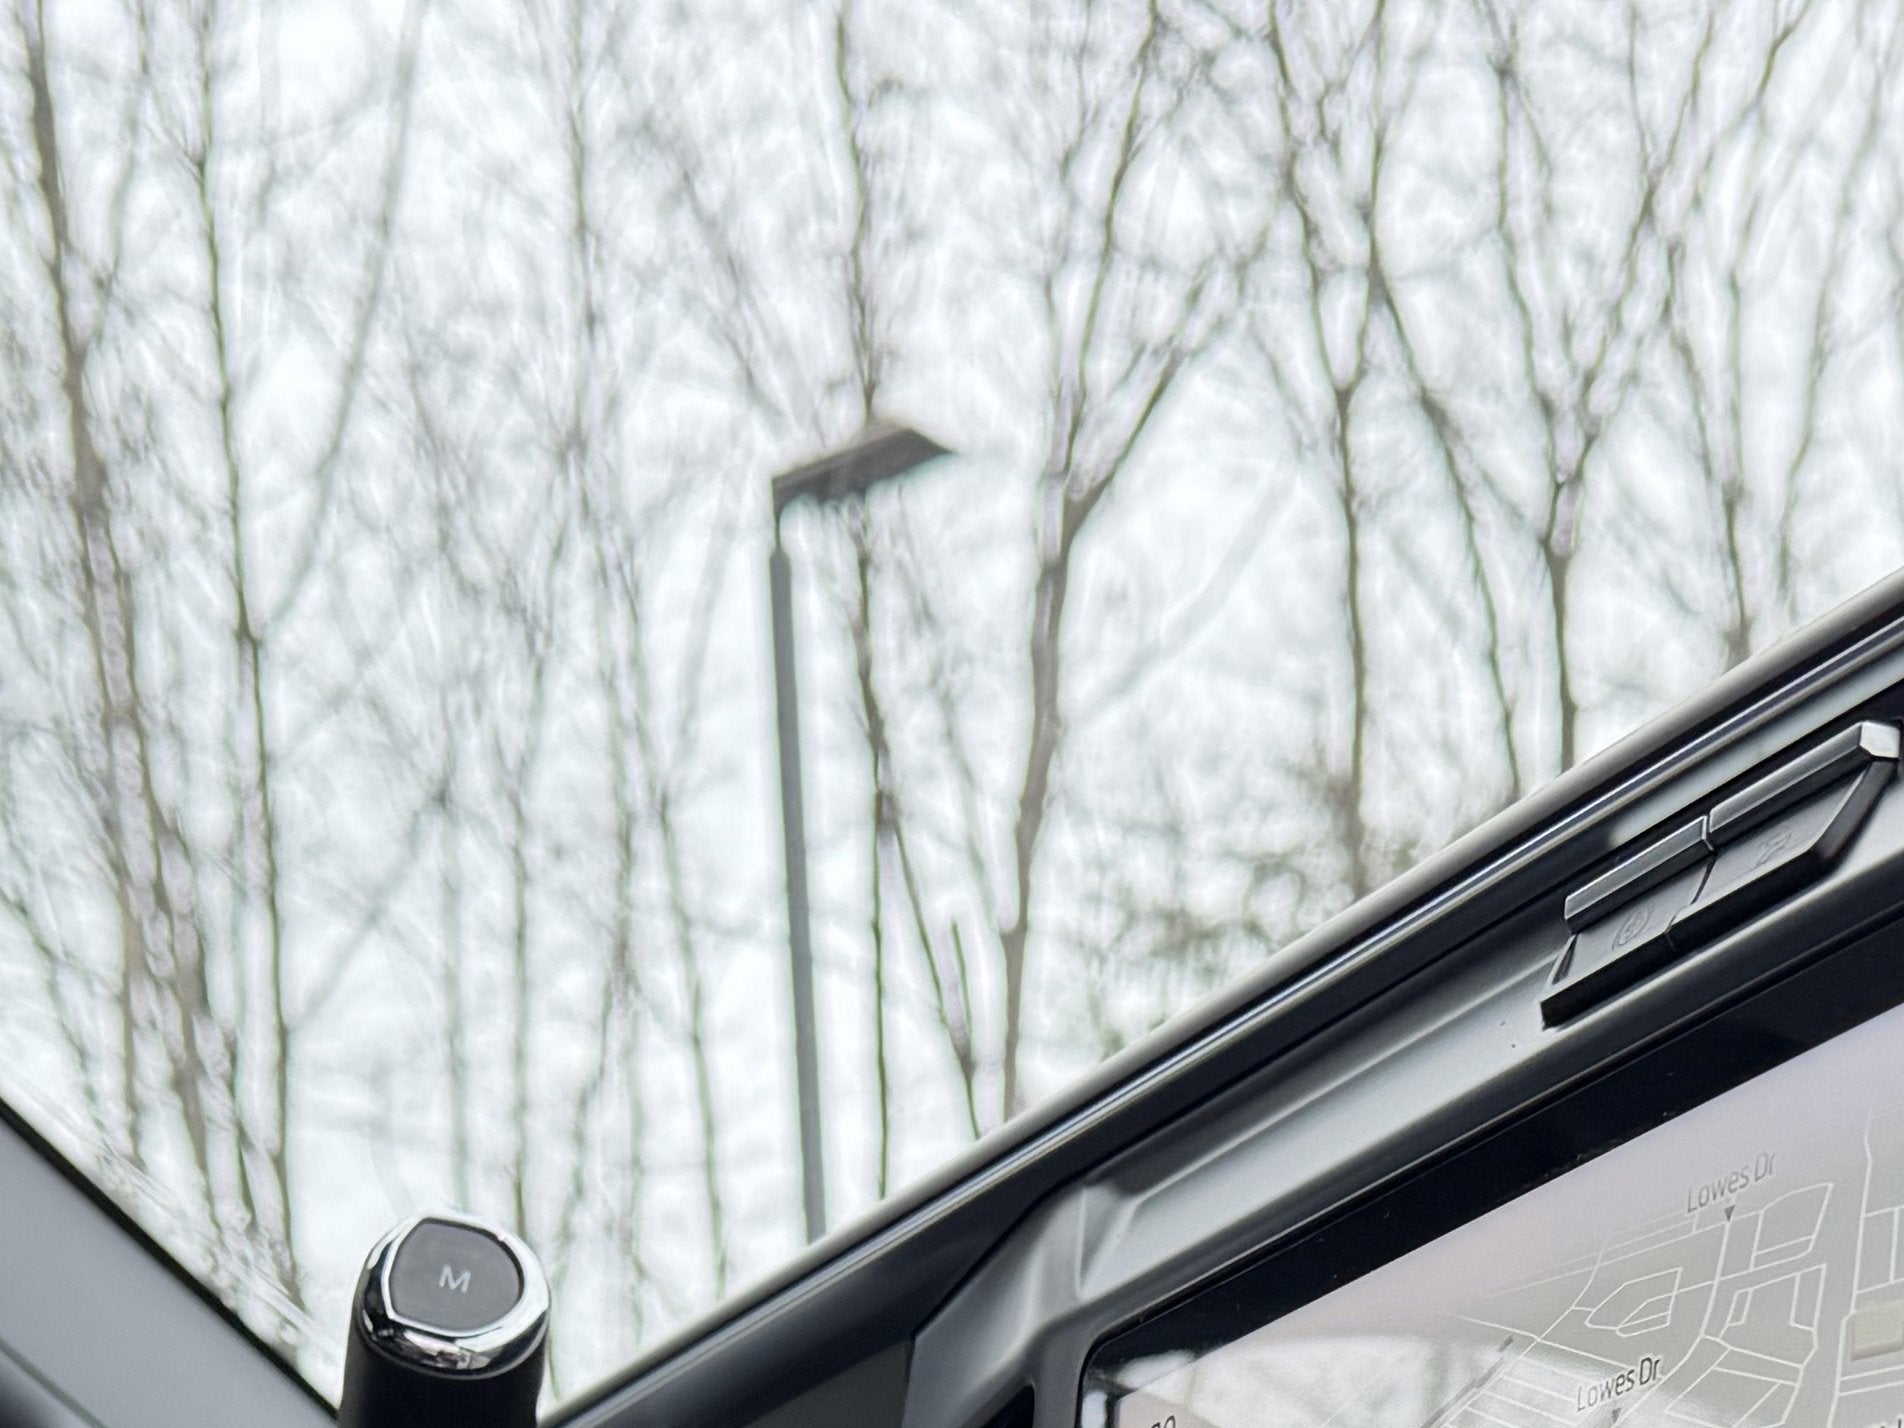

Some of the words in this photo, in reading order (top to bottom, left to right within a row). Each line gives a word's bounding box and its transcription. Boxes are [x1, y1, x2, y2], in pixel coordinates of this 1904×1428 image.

[1687, 1169, 1751, 1214] Lowes
[1754, 1152, 1776, 1191] Dr
[438, 1264, 471, 1293] M
[1576, 1370, 1637, 1413] Lowes
[1638, 1356, 1661, 1390] Dr
